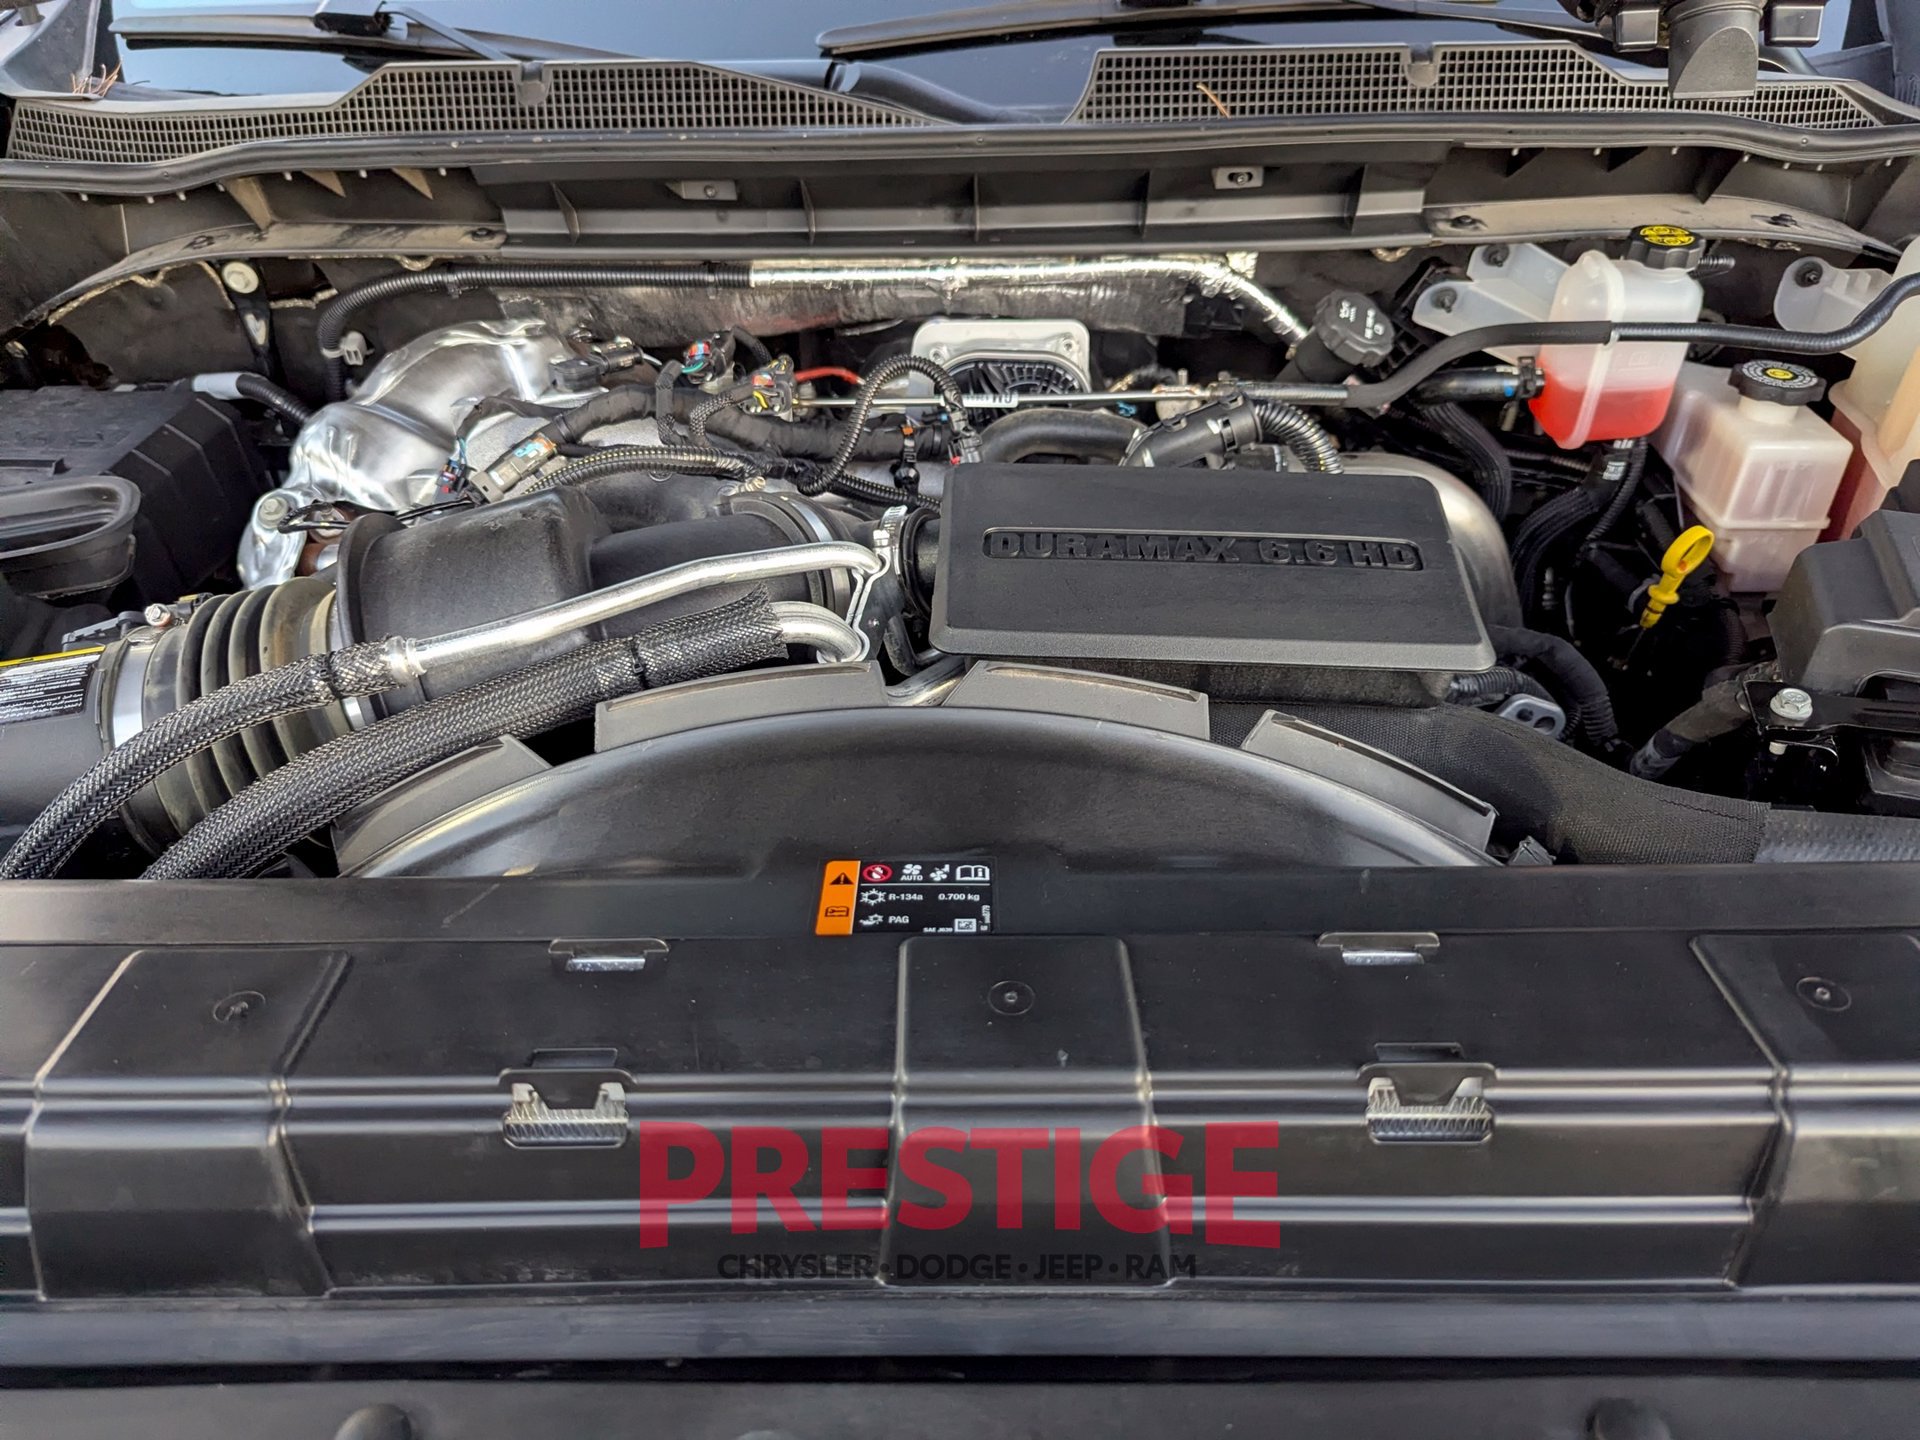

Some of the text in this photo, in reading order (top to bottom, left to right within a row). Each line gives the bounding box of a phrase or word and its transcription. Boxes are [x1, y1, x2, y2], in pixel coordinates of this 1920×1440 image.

[989, 531, 1416, 570] DURAMAX 6.6 HD
[888, 893, 980, 902] R-134a 0.700 kg
[888, 915, 909, 924] PAG
